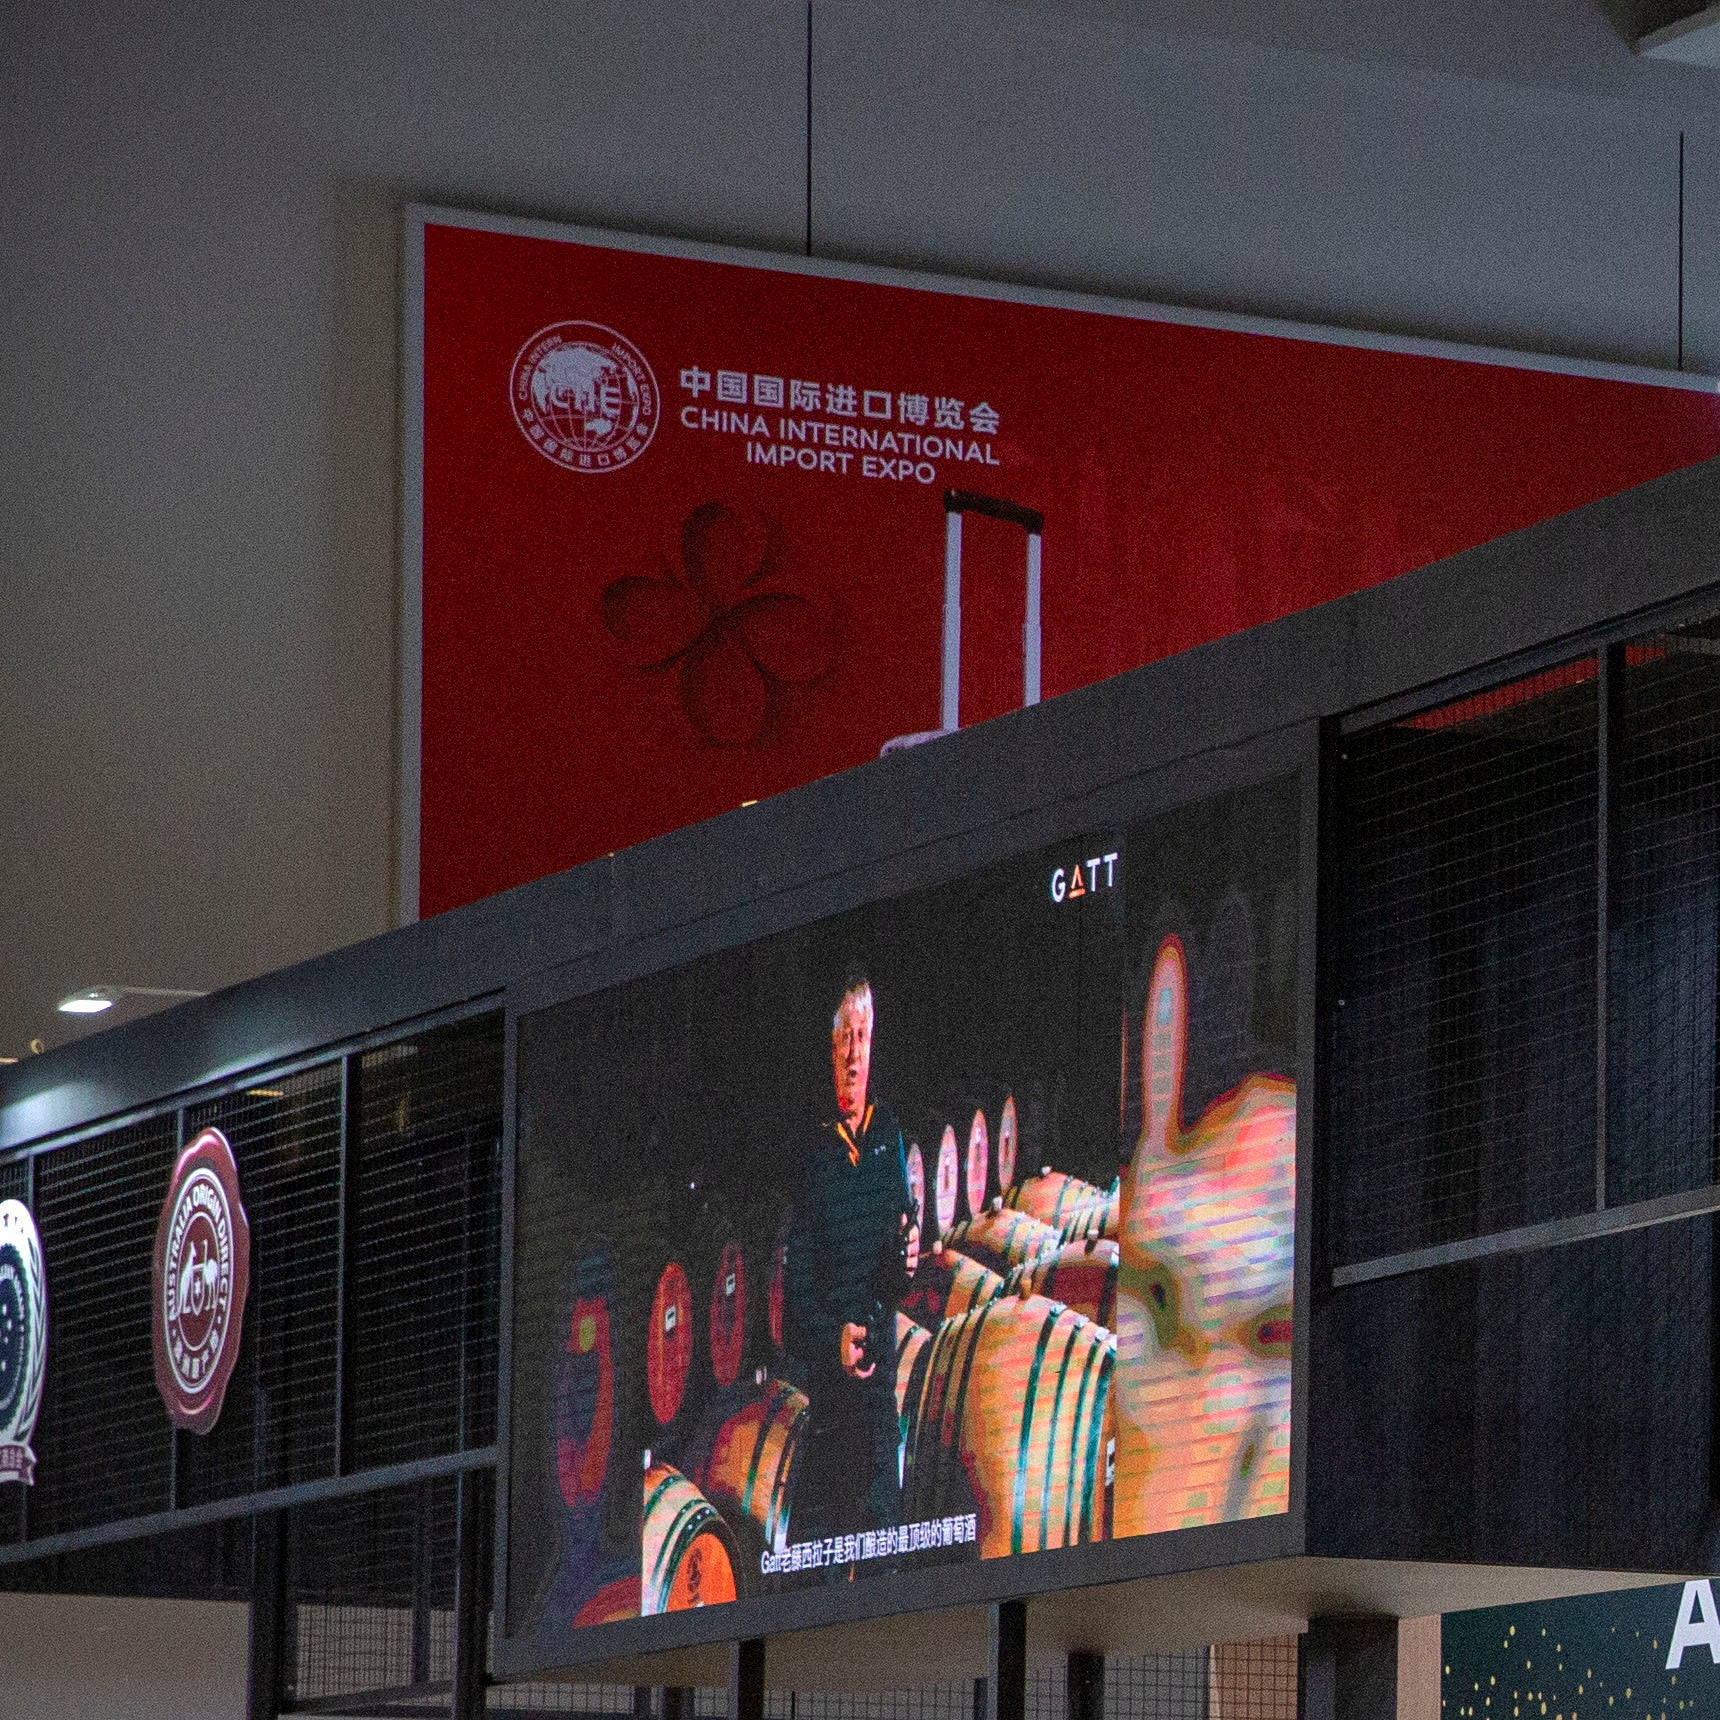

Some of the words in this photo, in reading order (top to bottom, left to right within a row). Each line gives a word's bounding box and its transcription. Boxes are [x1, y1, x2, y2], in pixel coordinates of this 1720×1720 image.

[680, 364, 1001, 436] 中国国际进口博览会
[680, 405, 771, 441] CHINA
[778, 415, 1001, 467] INTERNATIONAL
[746, 441, 852, 477] IMPORT
[860, 454, 937, 486] EXPO
[1050, 852, 1120, 905] GATT
